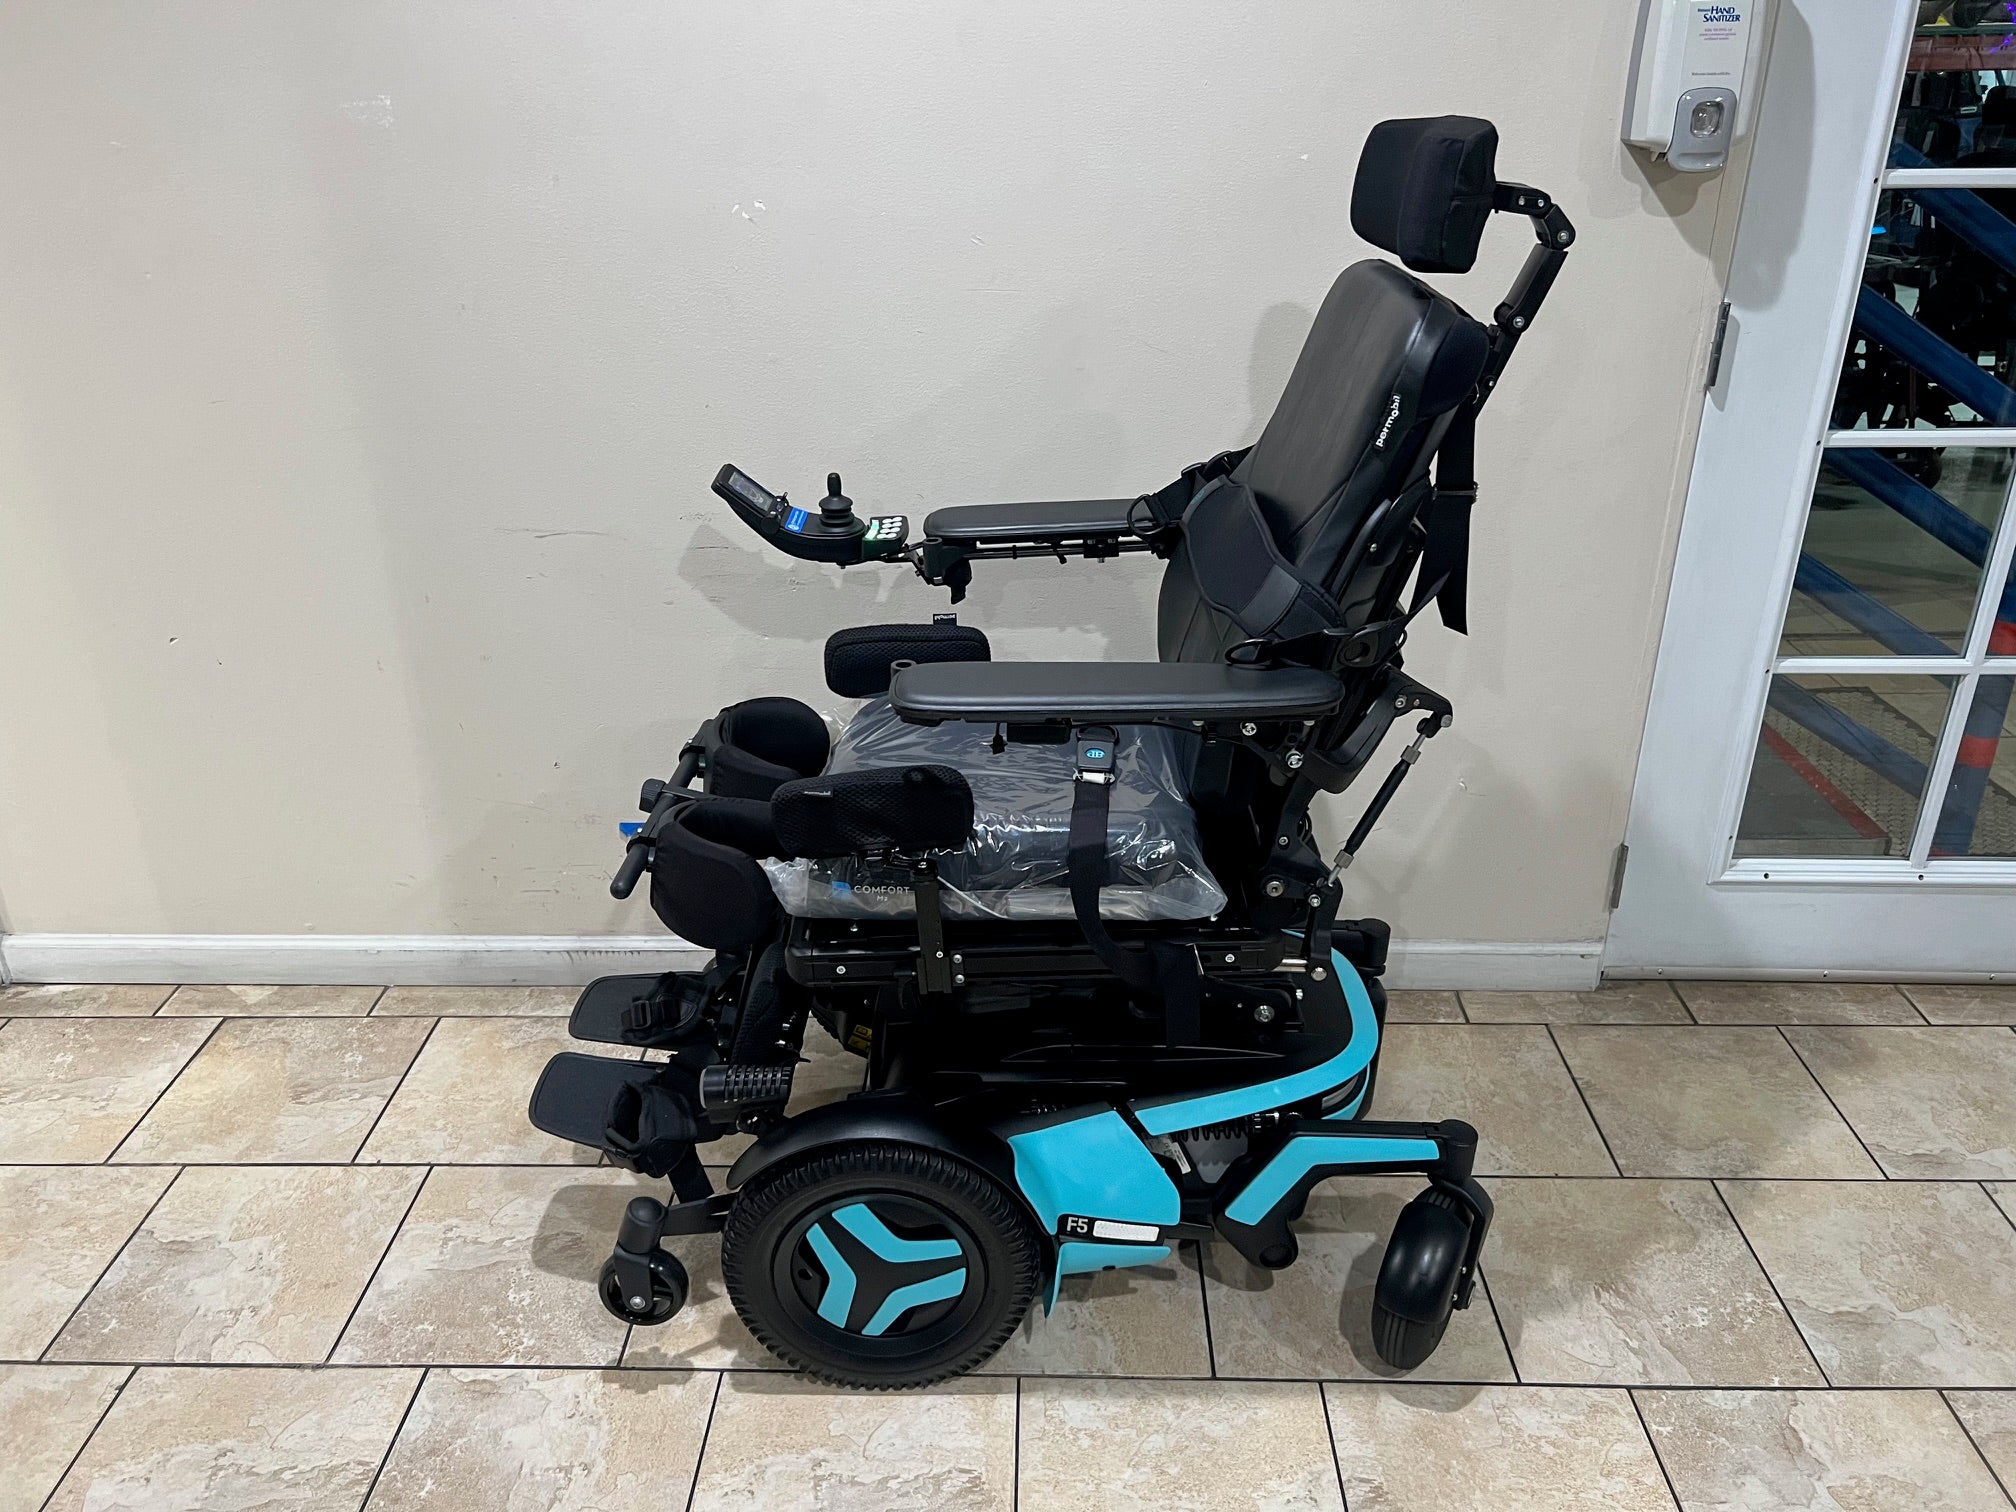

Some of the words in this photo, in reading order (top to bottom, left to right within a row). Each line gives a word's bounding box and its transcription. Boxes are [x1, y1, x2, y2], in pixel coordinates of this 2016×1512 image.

[1710, 5, 1735, 14] HAND
[1703, 13, 1741, 22] SANITIZER
[1375, 395, 1401, 447] permobil
[854, 885, 910, 894] COMFORT
[1066, 1216, 1089, 1233] F5
